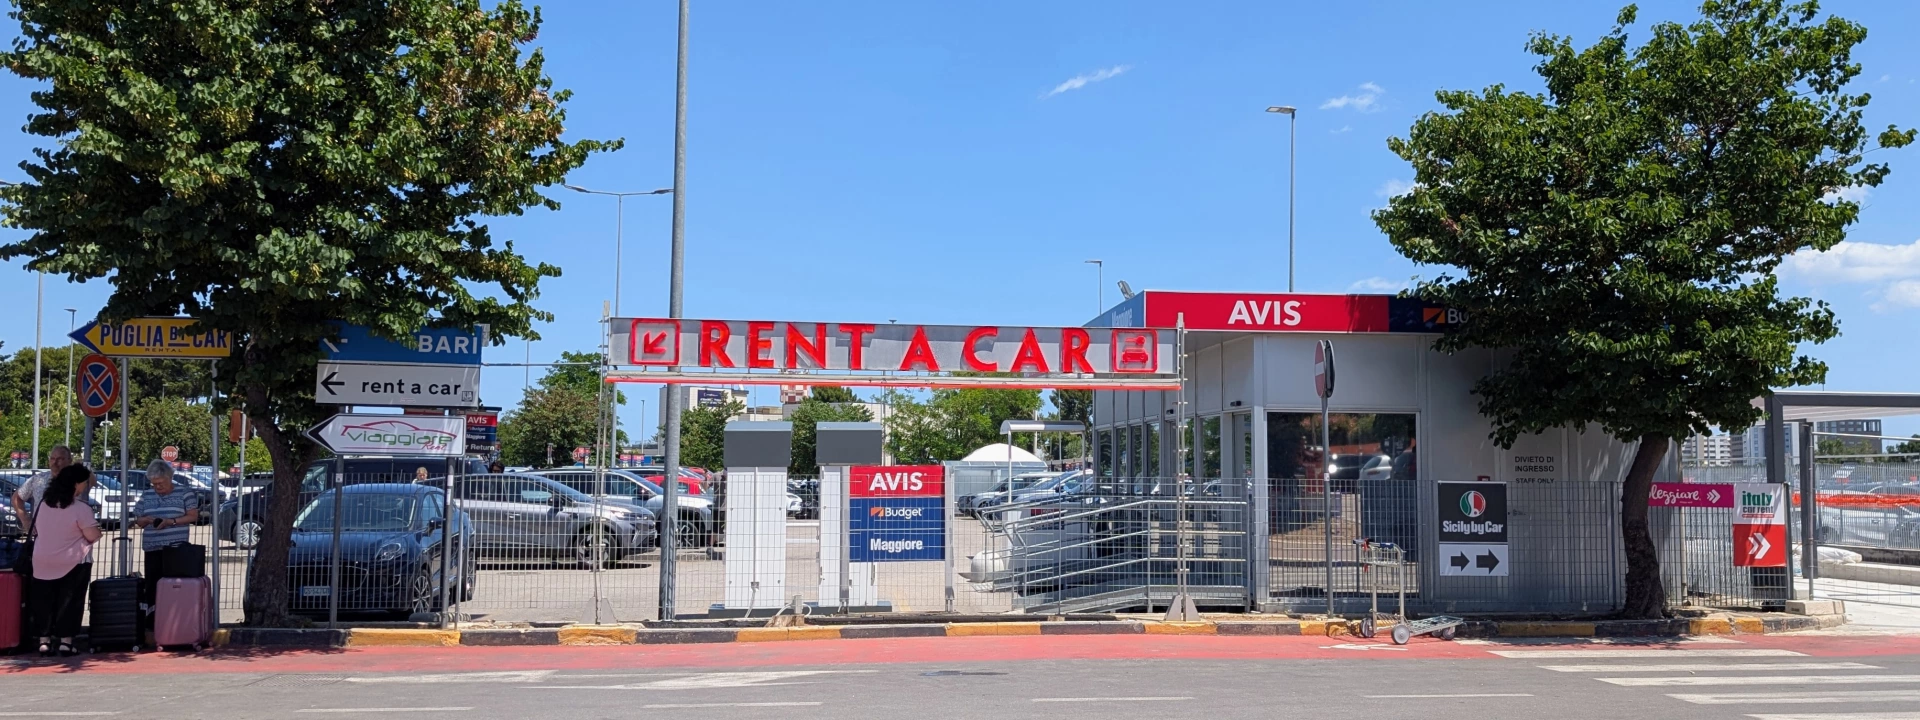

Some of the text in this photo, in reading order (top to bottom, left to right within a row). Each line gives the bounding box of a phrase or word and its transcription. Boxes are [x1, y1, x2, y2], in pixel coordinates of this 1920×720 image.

[1227, 300, 1301, 326] AVIS
[100, 324, 164, 347] PUGLIA
[193, 328, 228, 348] CAR
[418, 334, 478, 355] BARI
[700, 320, 1095, 374] RENT A CAR
[361, 378, 461, 396] rent a car
[467, 416, 488, 424] AVIS
[161, 449, 177, 457] STOP
[421, 440, 448, 451] Rent
[470, 443, 495, 451] Return
[1514, 465, 1555, 473] INGRESSO
[869, 471, 923, 491] AVIS
[1649, 484, 1700, 505] leggiare
[1742, 490, 1773, 506] italy
[884, 506, 922, 520] Budget
[1742, 505, 1774, 514] car rent
[870, 538, 923, 553] Maggiore
